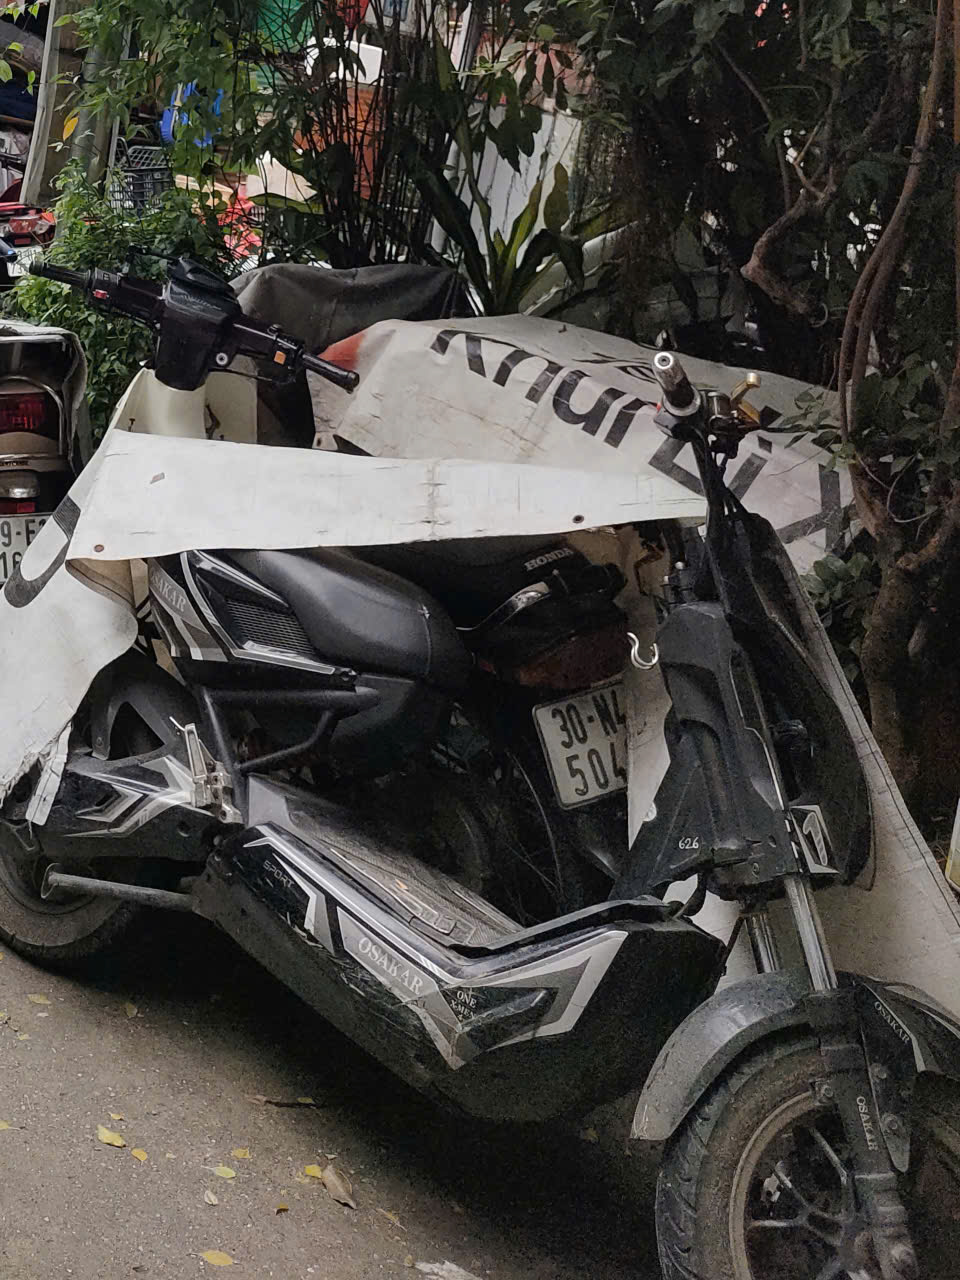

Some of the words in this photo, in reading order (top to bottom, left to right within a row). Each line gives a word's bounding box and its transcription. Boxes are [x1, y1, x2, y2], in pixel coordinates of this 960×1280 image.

[524, 548, 574, 572] HONDA
[678, 836, 700, 851] 626
[262, 859, 295, 888] SPORT
[358, 936, 423, 996] OSAKAR
[457, 989, 477, 1009] ONE
[874, 1001, 910, 1044] OSAKAR
[856, 1096, 879, 1151] OSAKAR
